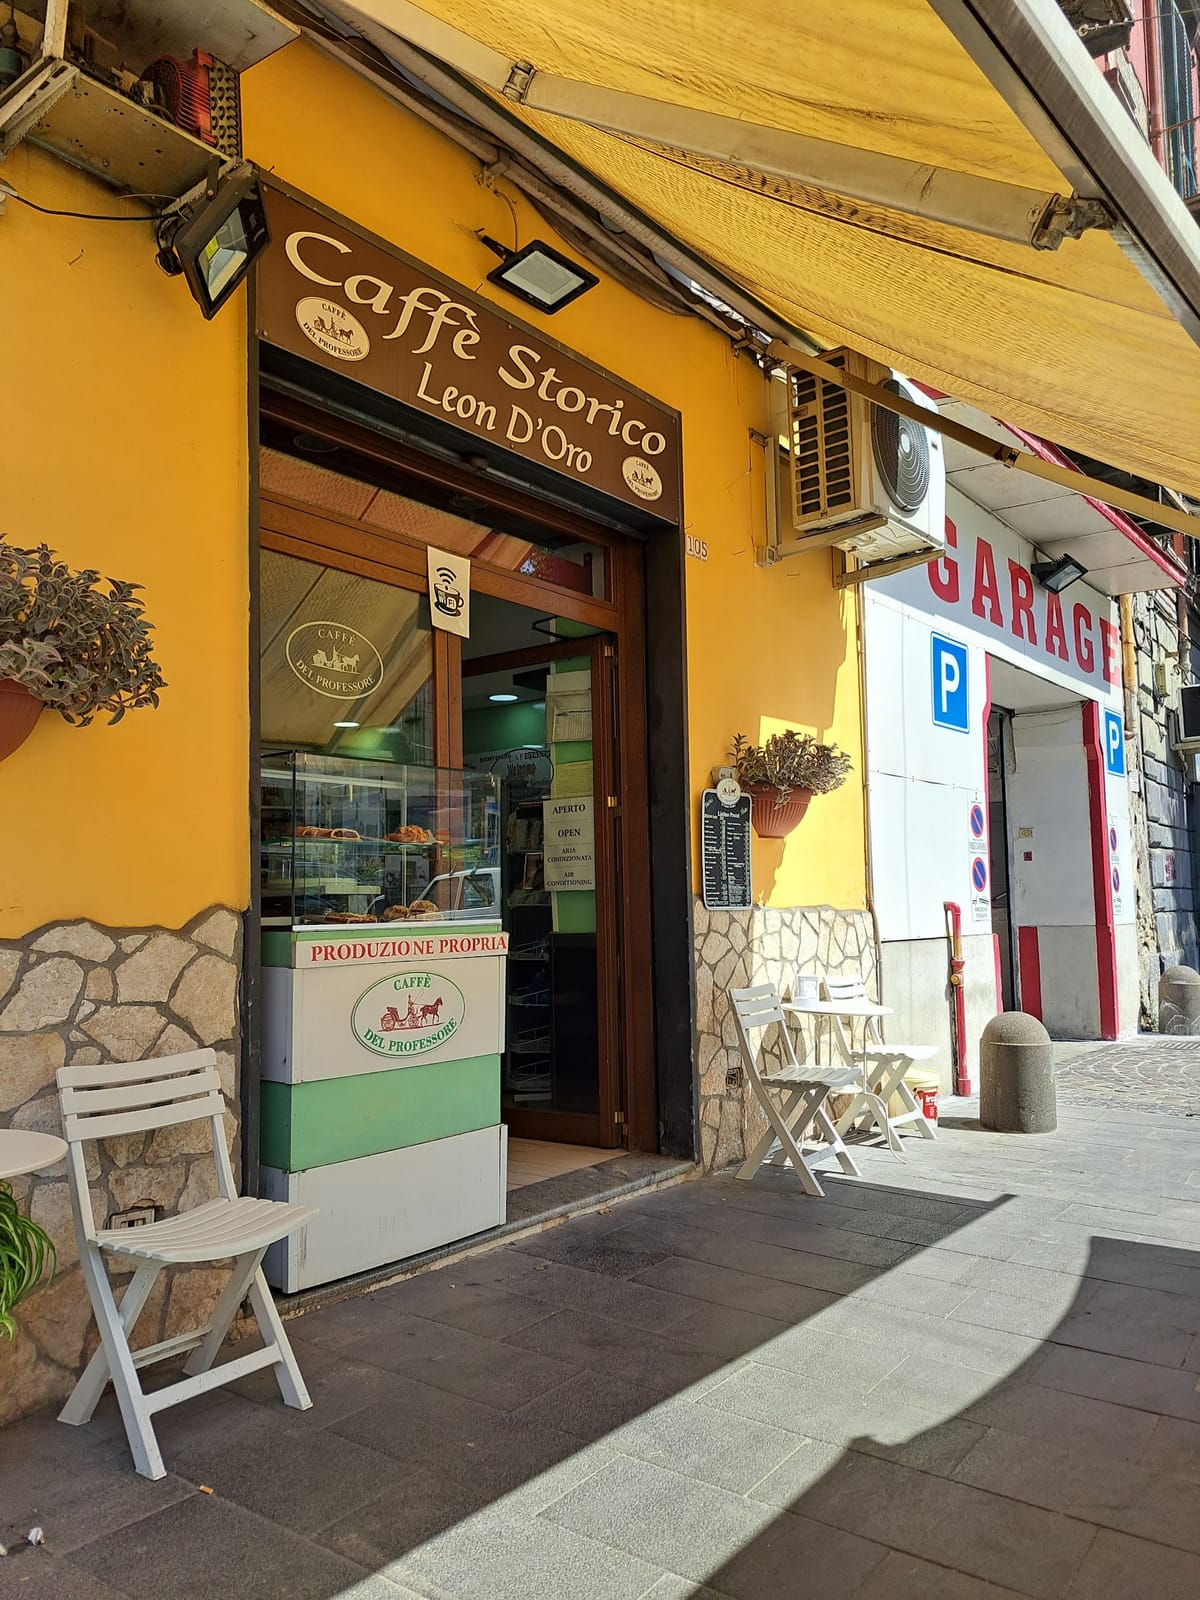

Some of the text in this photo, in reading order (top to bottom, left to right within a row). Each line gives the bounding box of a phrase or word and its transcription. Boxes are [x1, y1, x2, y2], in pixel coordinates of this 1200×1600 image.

[285, 231, 666, 455] Caffè Storico
[303, 321, 363, 357] DEL PROFESSORE
[417, 361, 592, 472] Leon D'Oro
[687, 535, 708, 558] 105
[927, 515, 1122, 688] GARAGE
[318, 628, 357, 646] CAFFÈ
[296, 659, 376, 692] DEL PROFESSORE
[940, 650, 960, 713] P
[1108, 719, 1120, 765] P
[552, 804, 586, 815] APERTO
[557, 828, 581, 838] OPEN
[547, 855, 592, 863] CONDIZIONATA
[546, 879, 593, 887] CONDITIONING
[311, 935, 507, 962] PRODUZIONE PROPRIA
[393, 974, 432, 991] CAFFÈ
[363, 1017, 458, 1052] DEL PROFESSORE
